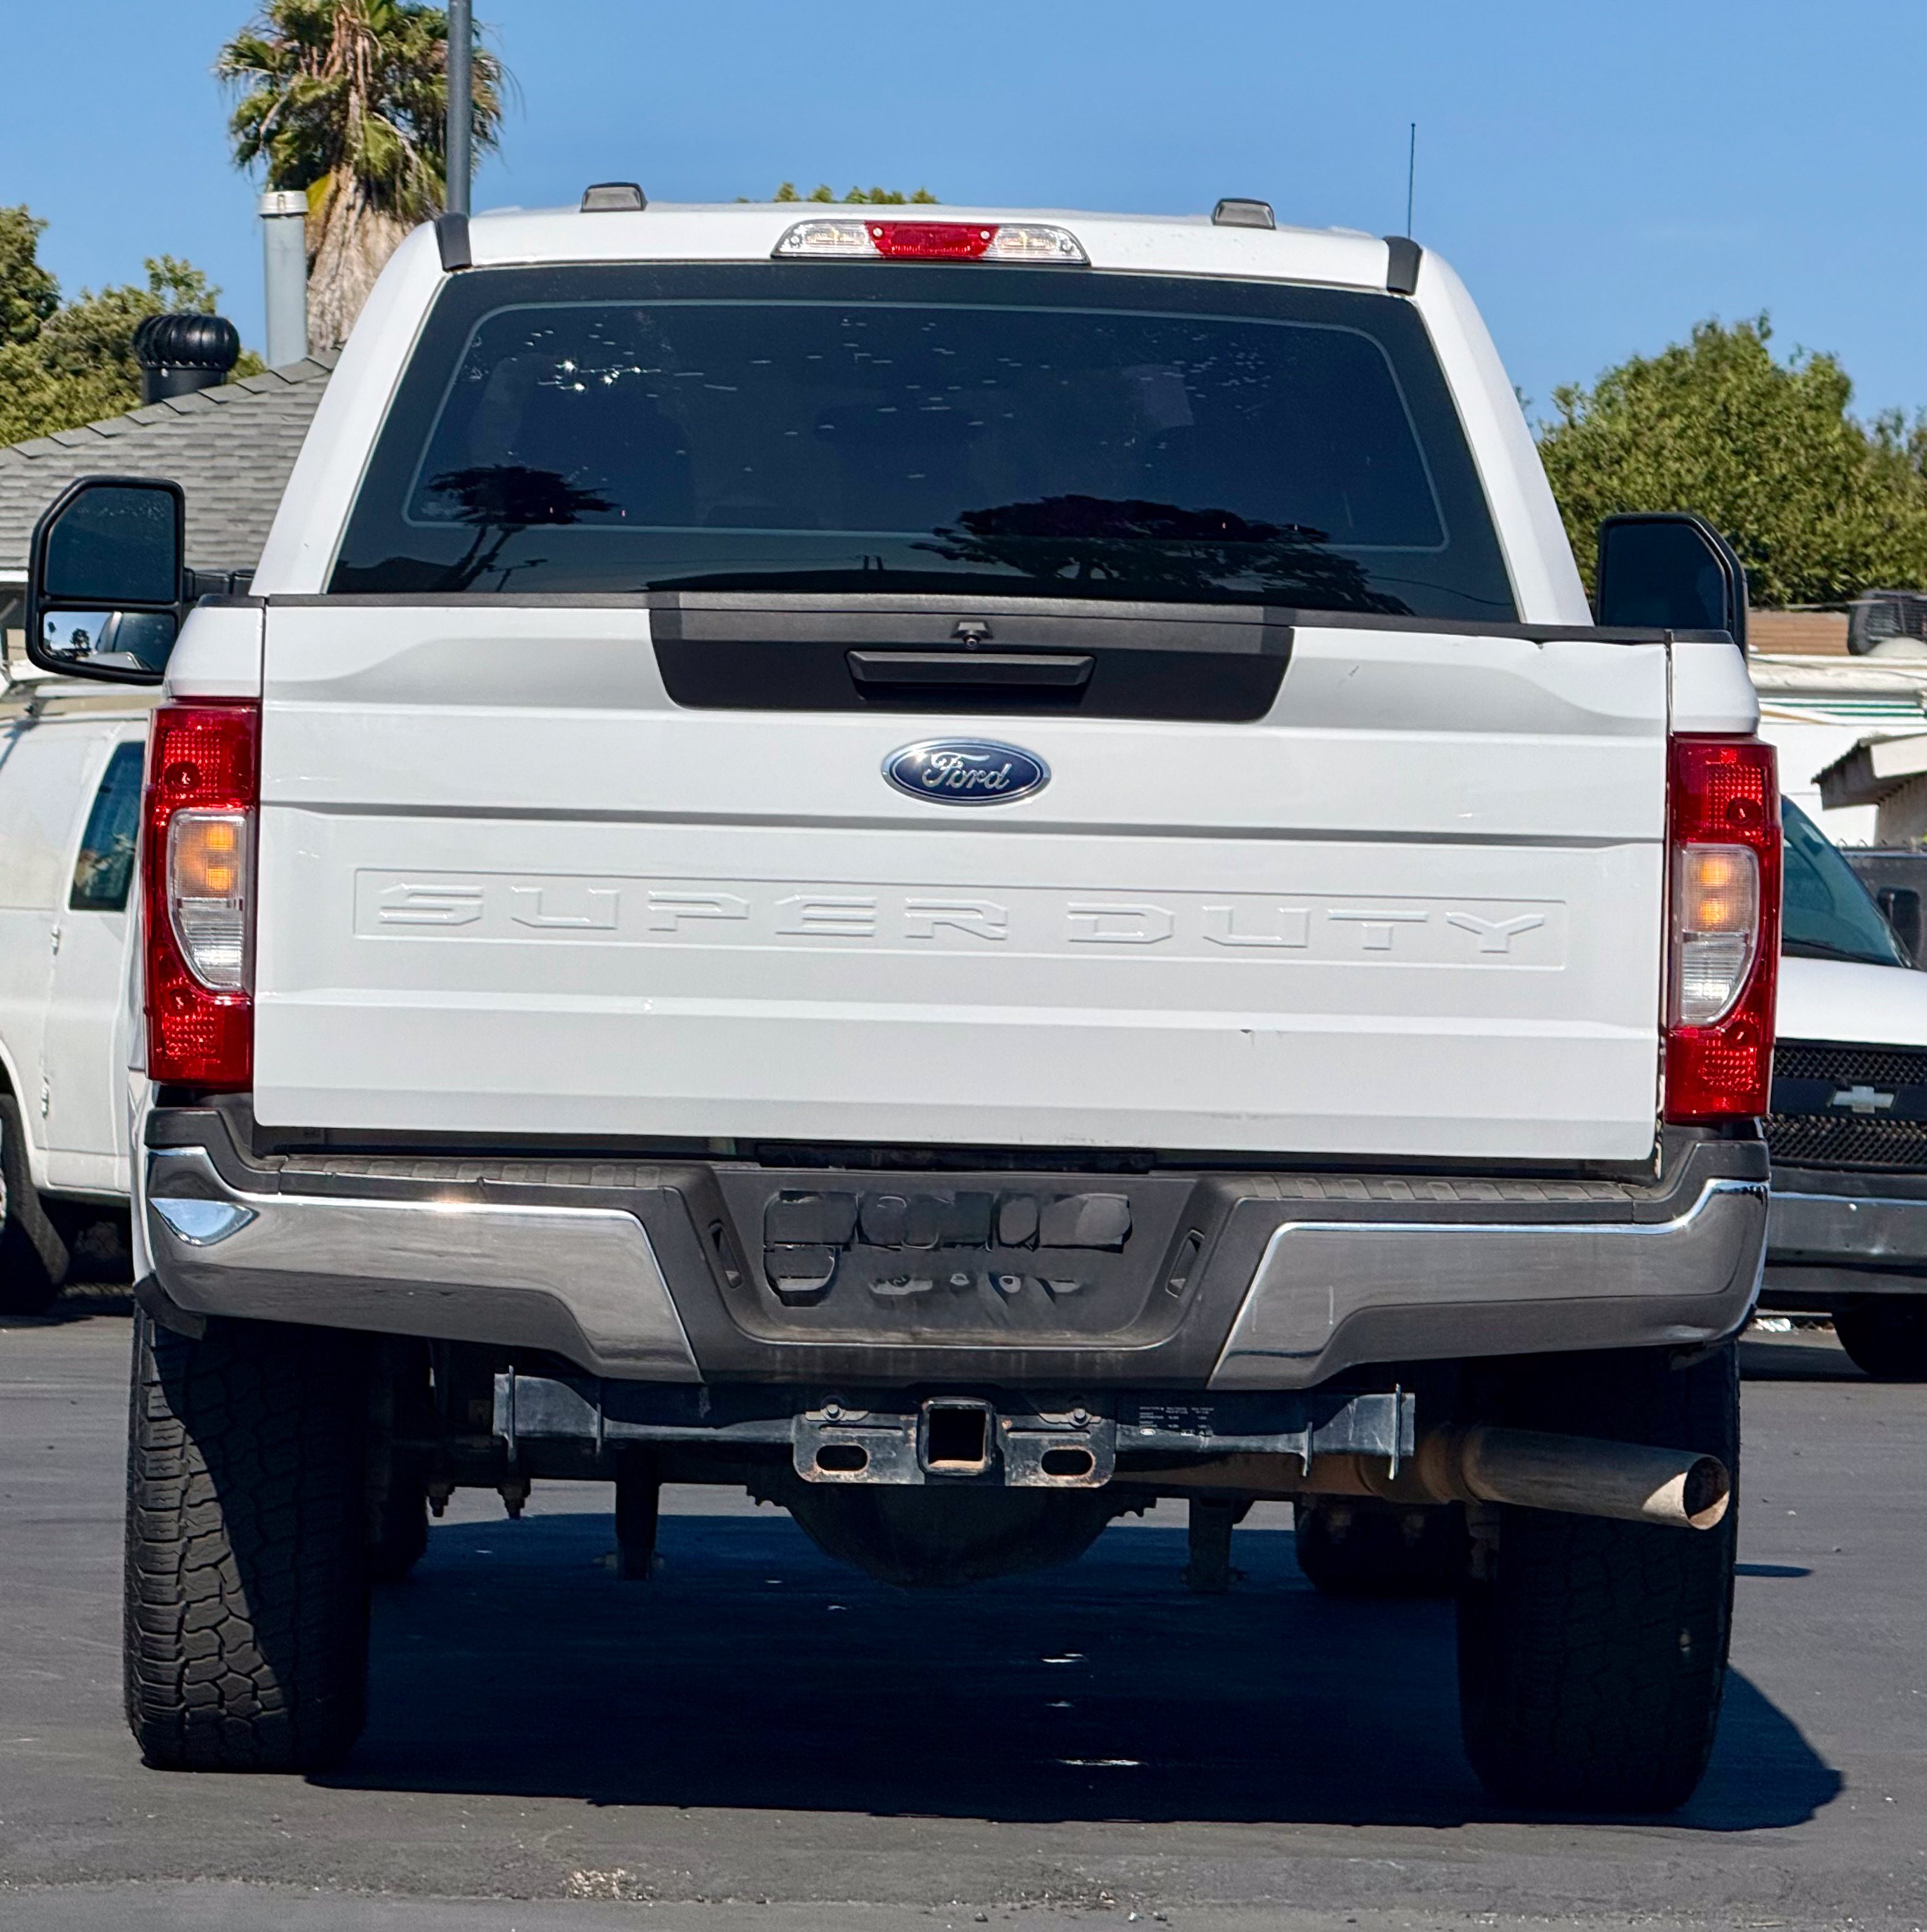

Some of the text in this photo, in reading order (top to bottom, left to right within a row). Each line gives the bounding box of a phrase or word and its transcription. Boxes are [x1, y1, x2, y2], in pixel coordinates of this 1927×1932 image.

[922, 751, 1012, 789] Ford
[379, 883, 1545, 954] SUPER DUTY
